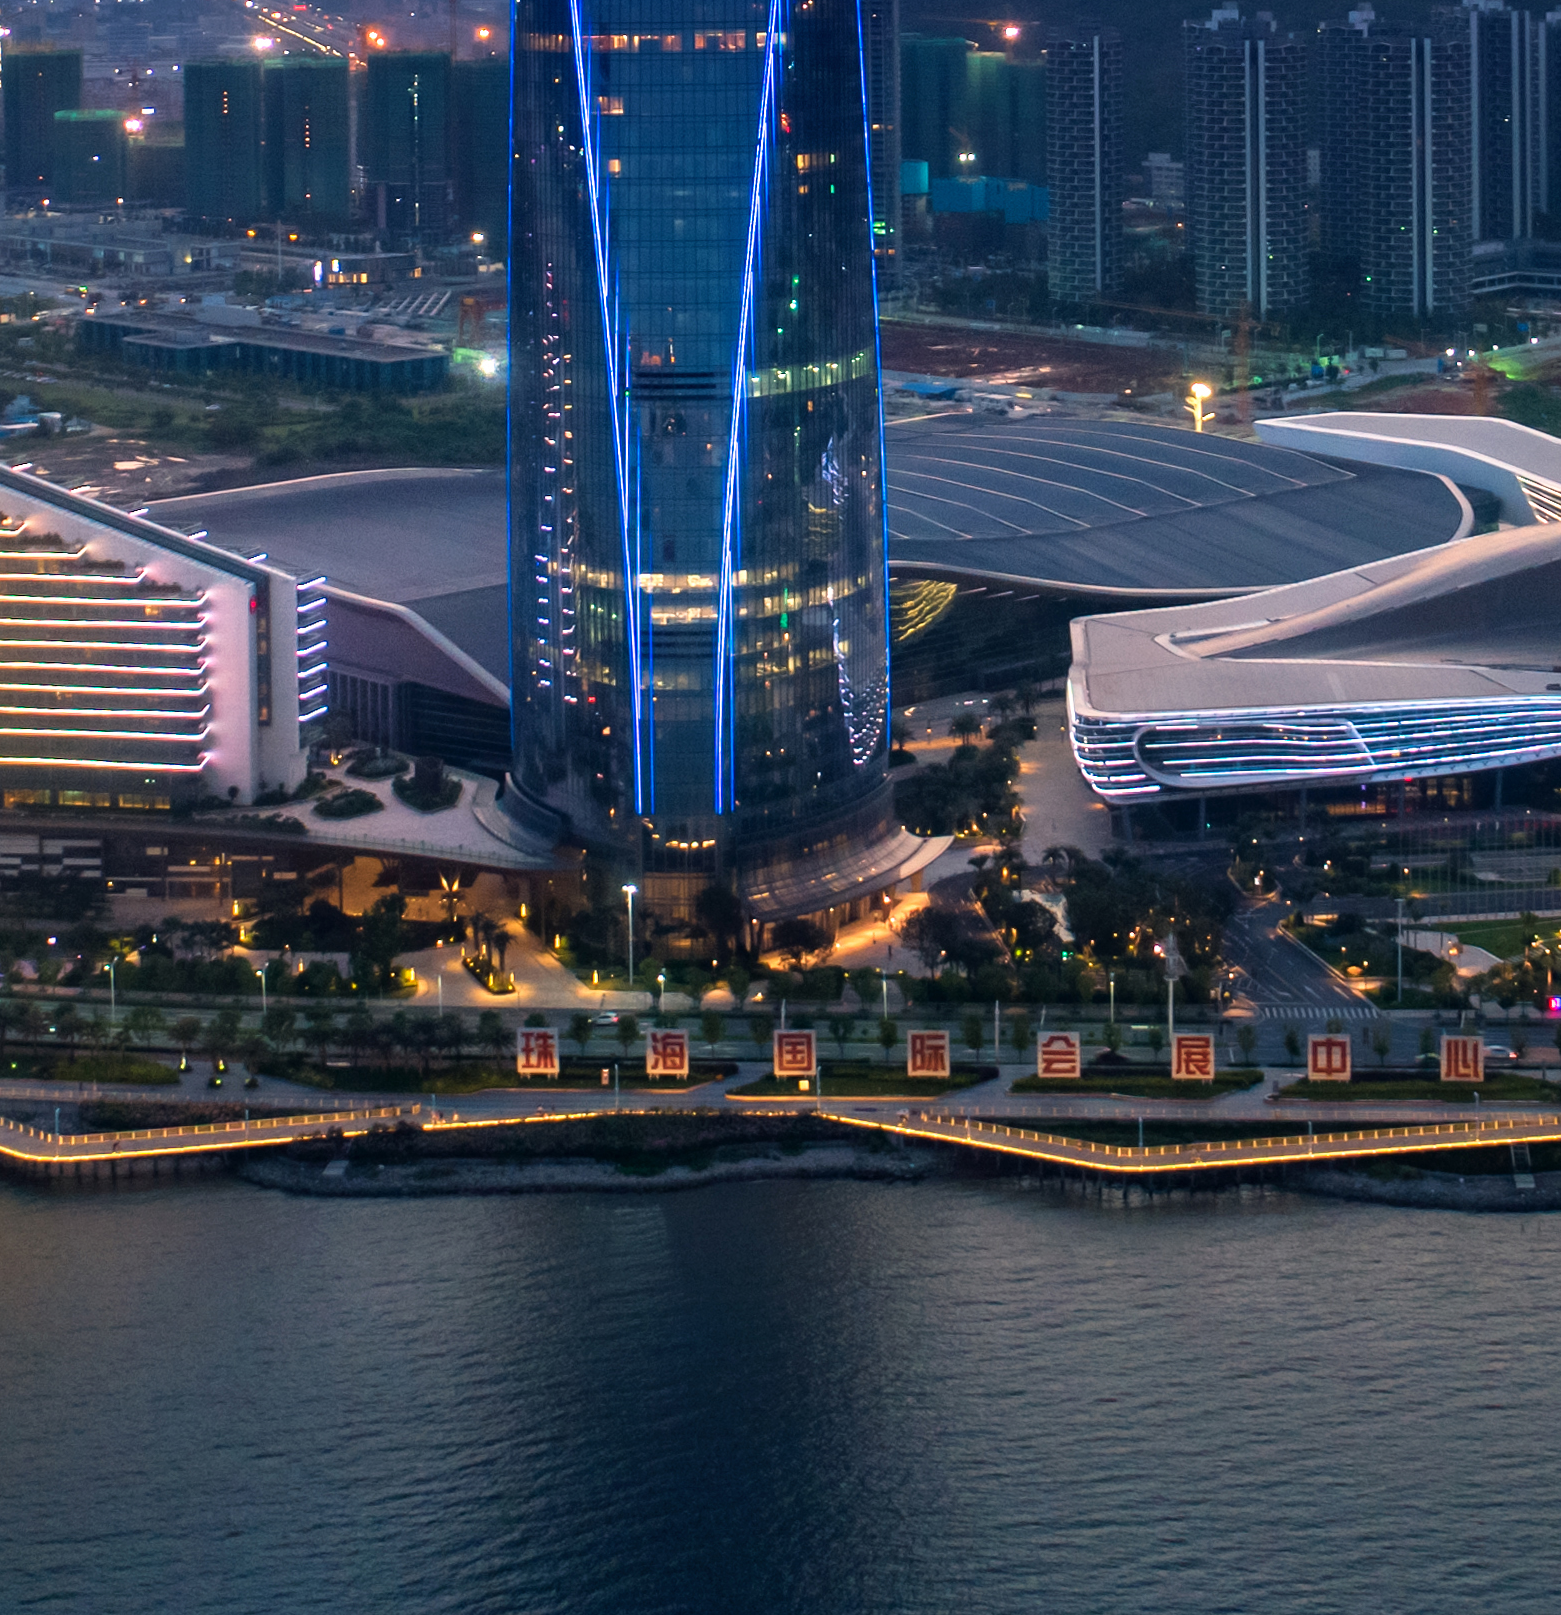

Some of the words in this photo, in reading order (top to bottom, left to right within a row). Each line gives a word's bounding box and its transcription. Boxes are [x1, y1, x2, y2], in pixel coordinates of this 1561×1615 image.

[521, 1031, 1481, 1078] 珠海国际会展中心
